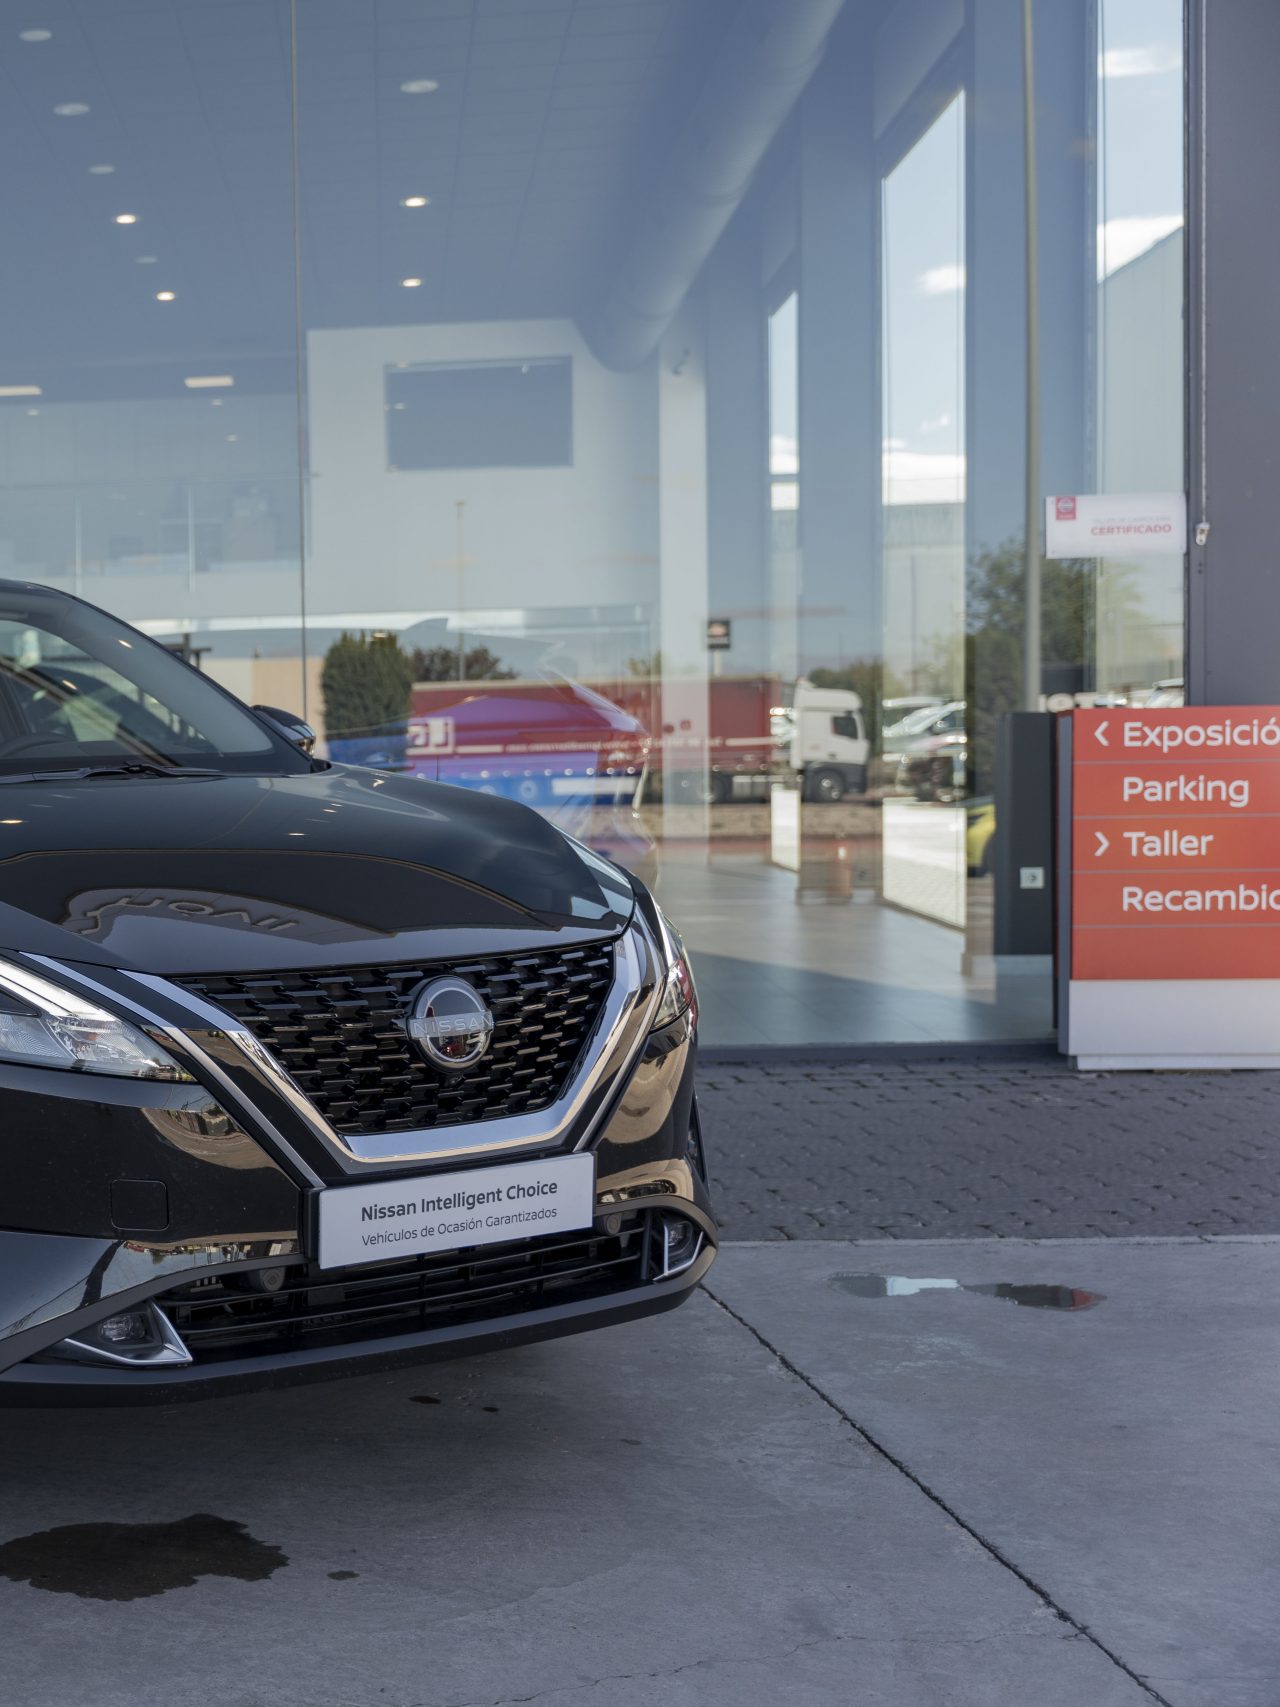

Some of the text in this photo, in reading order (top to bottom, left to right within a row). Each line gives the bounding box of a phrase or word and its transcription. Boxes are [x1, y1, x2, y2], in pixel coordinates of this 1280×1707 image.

[1090, 523, 1173, 537] CERTIFICADO
[1123, 717, 1280, 753] Exposició
[1123, 774, 1250, 808] Parking
[1122, 829, 1214, 857] Taller
[413, 1014, 495, 1035] NISSAN
[361, 1181, 558, 1222] Nissan Intelligent Choice
[362, 1207, 558, 1246] Vehículos de Ocasión Garantizados
